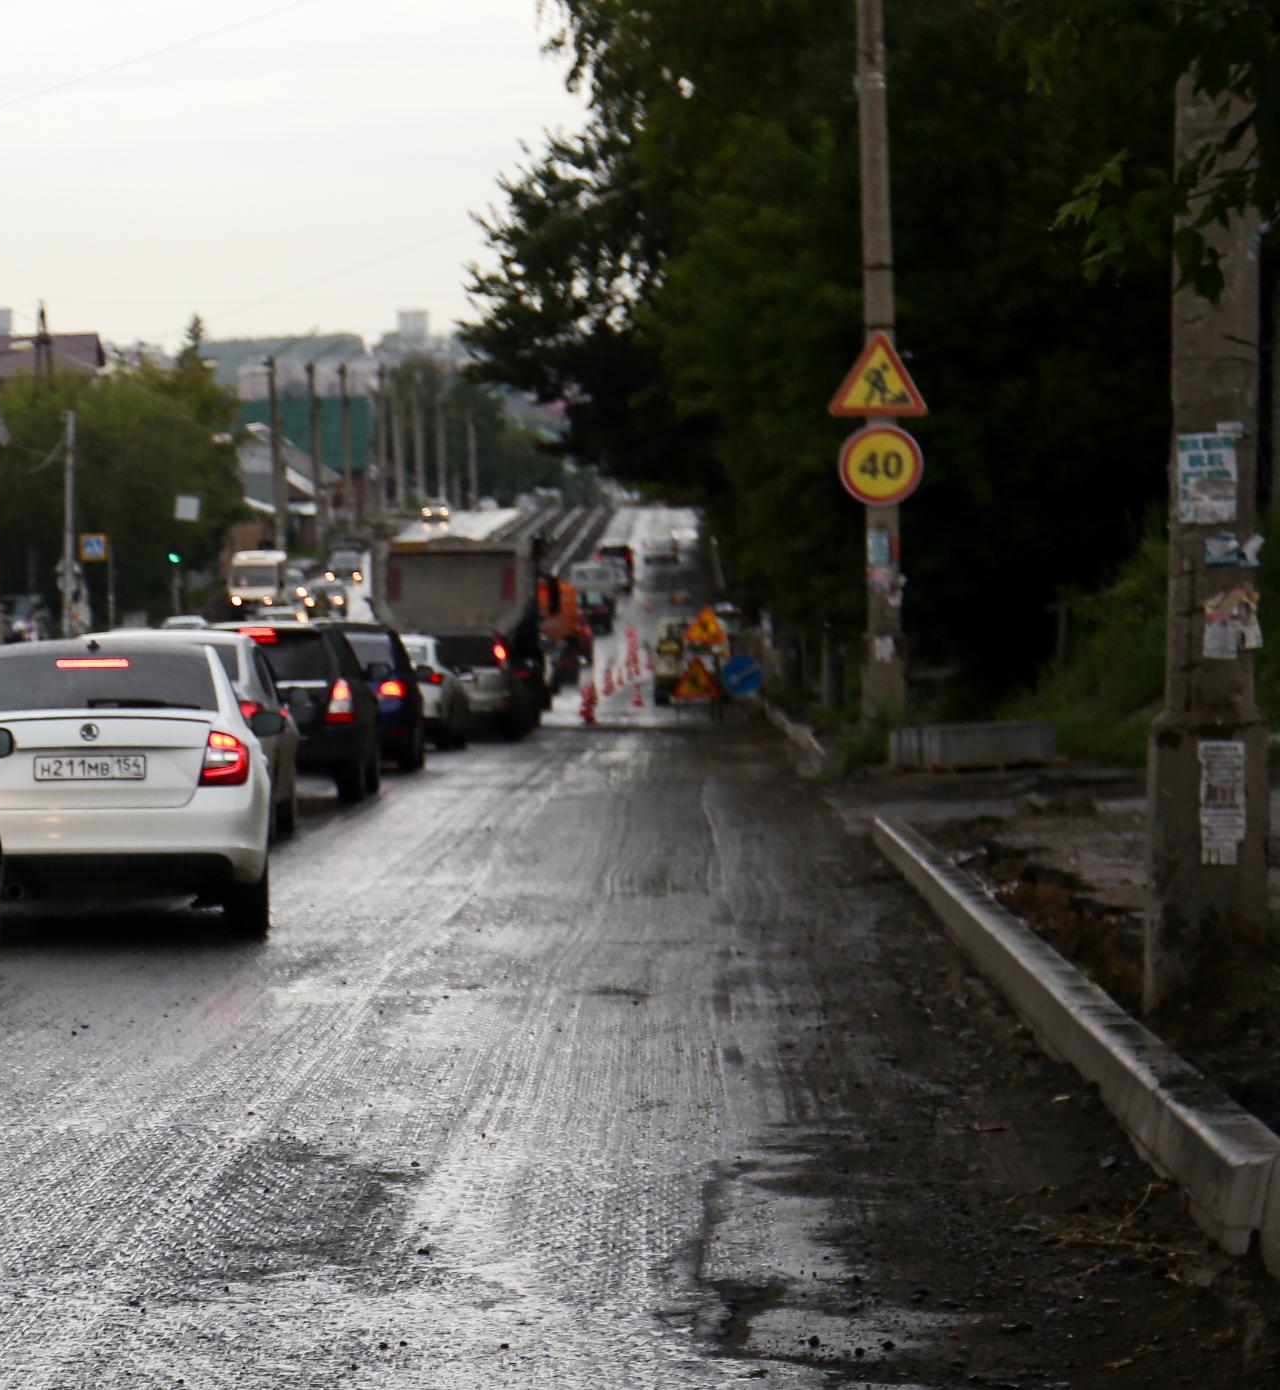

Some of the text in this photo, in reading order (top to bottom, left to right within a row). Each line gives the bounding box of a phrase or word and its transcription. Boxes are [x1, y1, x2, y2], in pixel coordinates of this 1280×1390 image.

[858, 450, 904, 481] 40
[40, 758, 141, 776] Н211МВ 154
